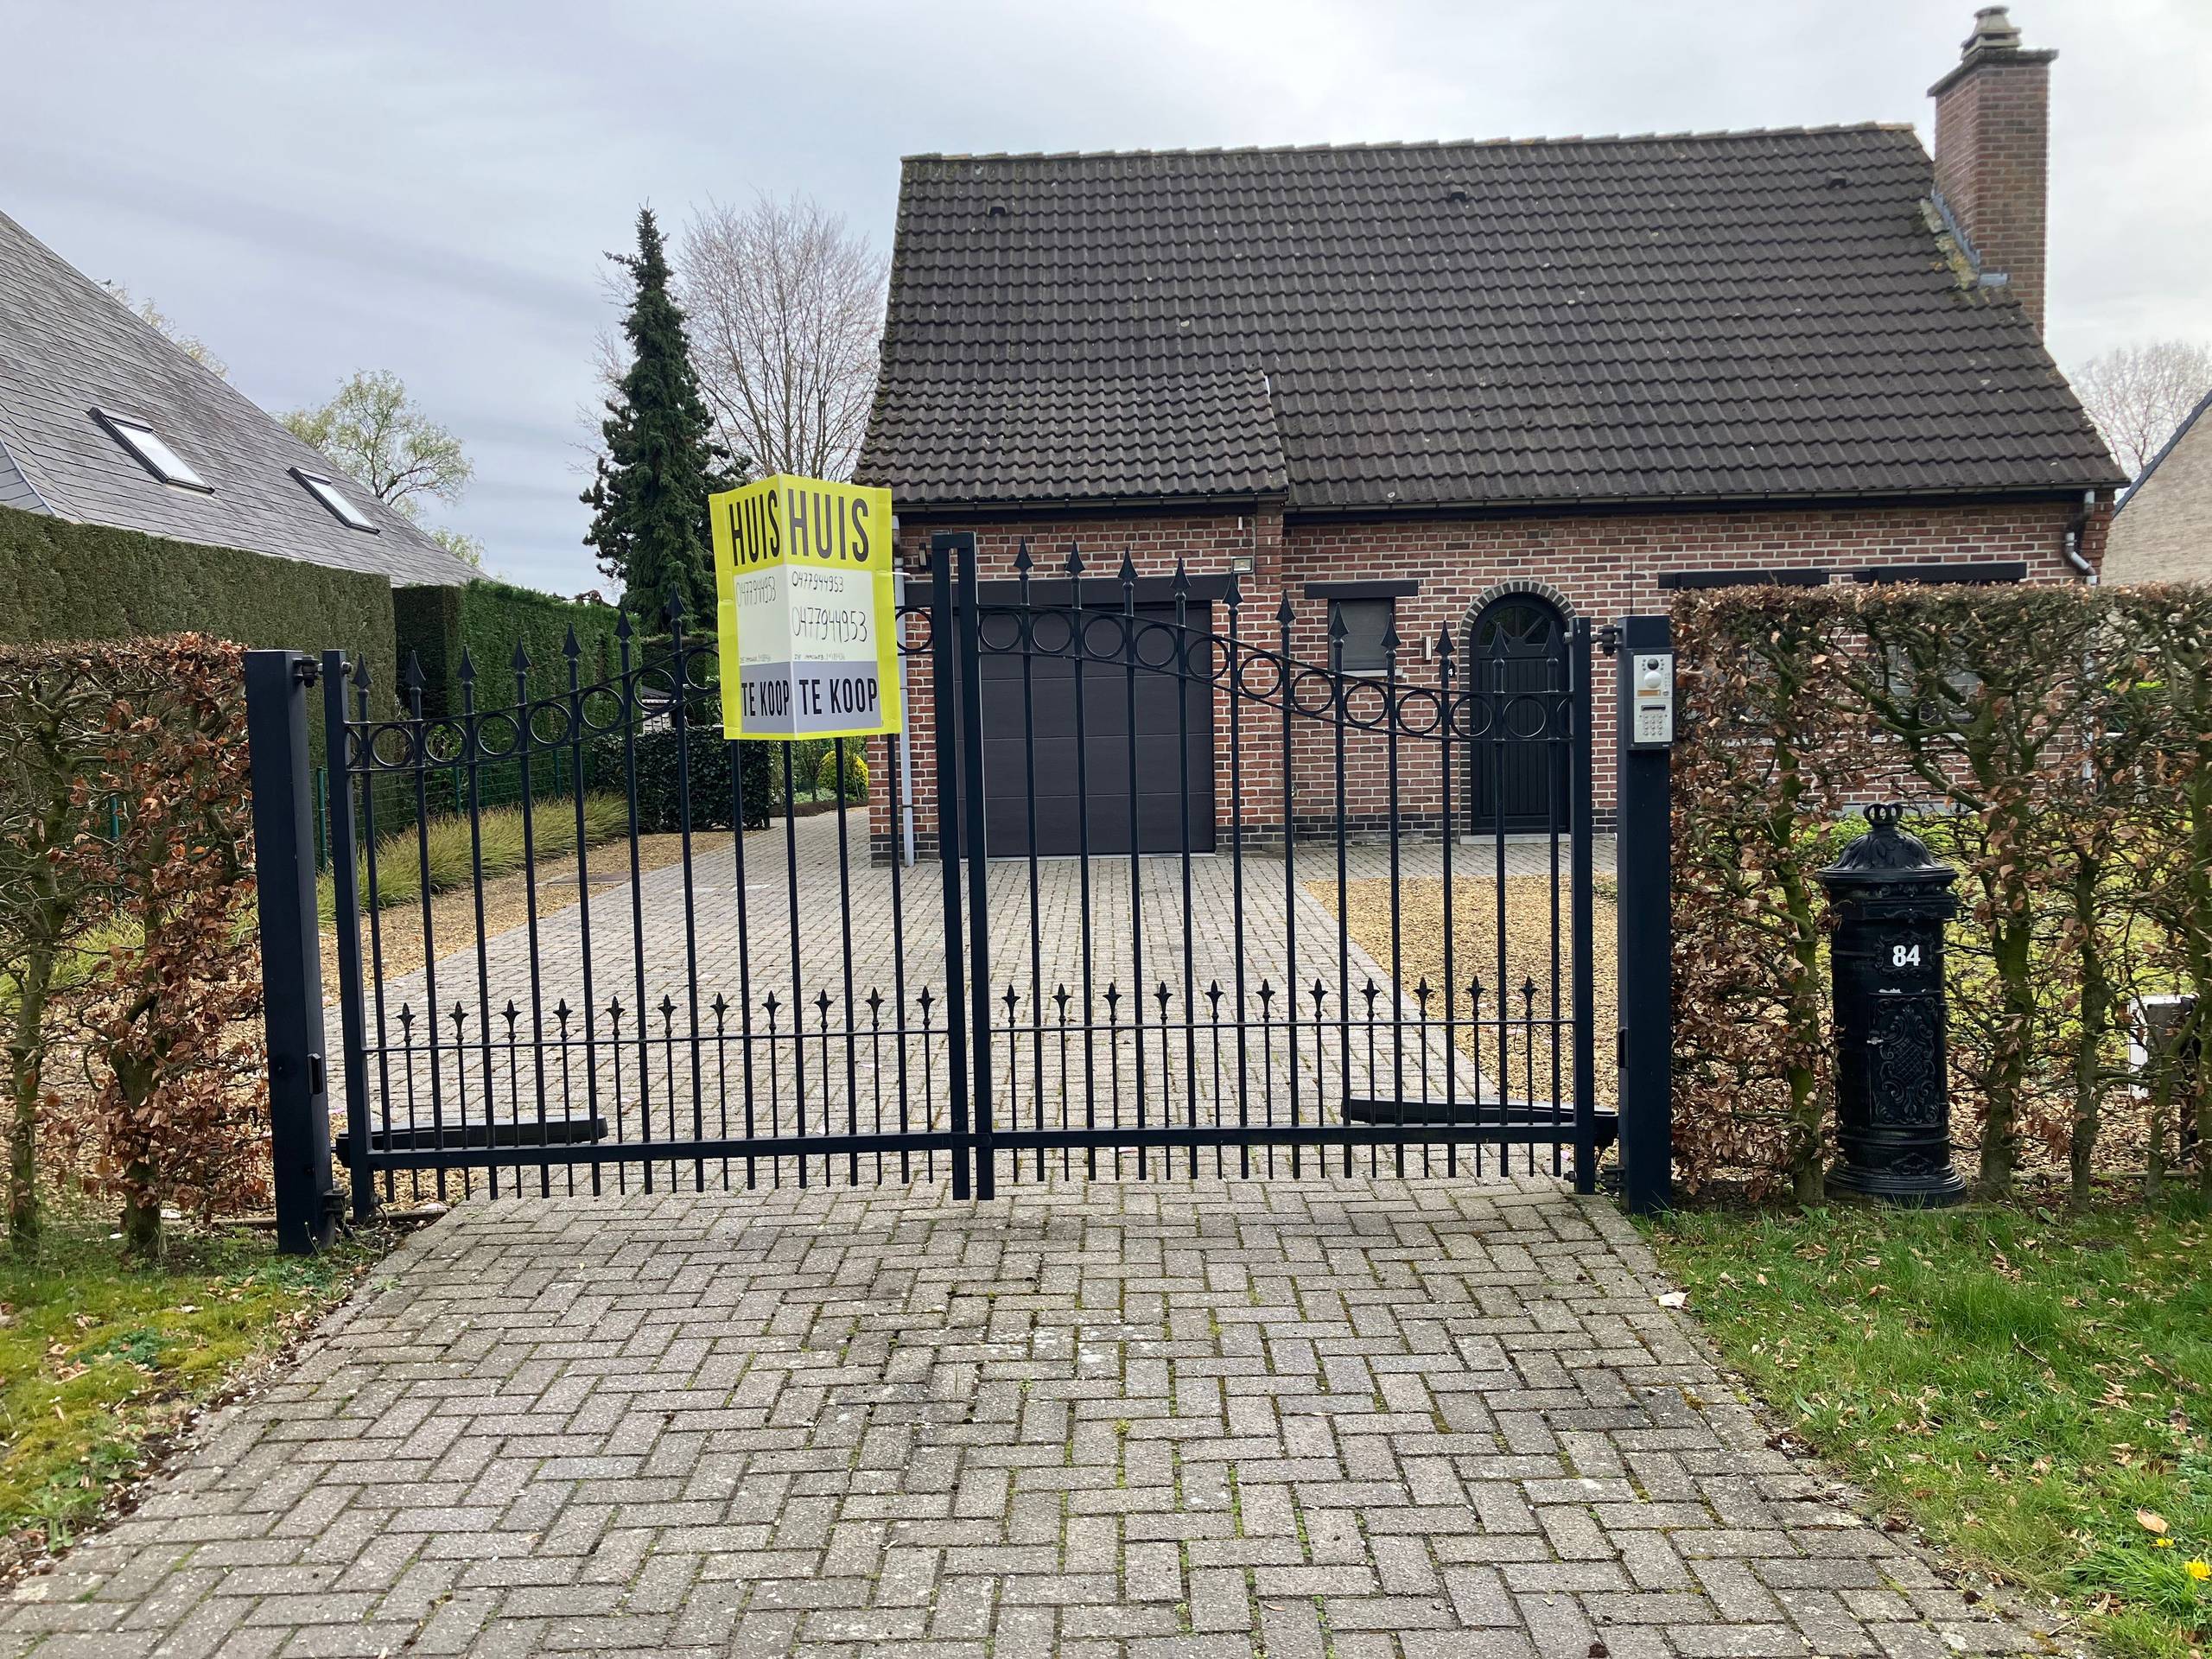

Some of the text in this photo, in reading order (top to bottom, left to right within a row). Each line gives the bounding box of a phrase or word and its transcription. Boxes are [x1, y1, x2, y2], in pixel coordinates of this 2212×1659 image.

[728, 489, 780, 567] HUIS
[787, 488, 869, 563] HUIS
[791, 570, 844, 593] 0477944953
[791, 606, 868, 643] 0477944953
[741, 680, 790, 716] TE KOOP
[798, 677, 878, 715] TE KOOP
[1892, 944, 1921, 967] 84
